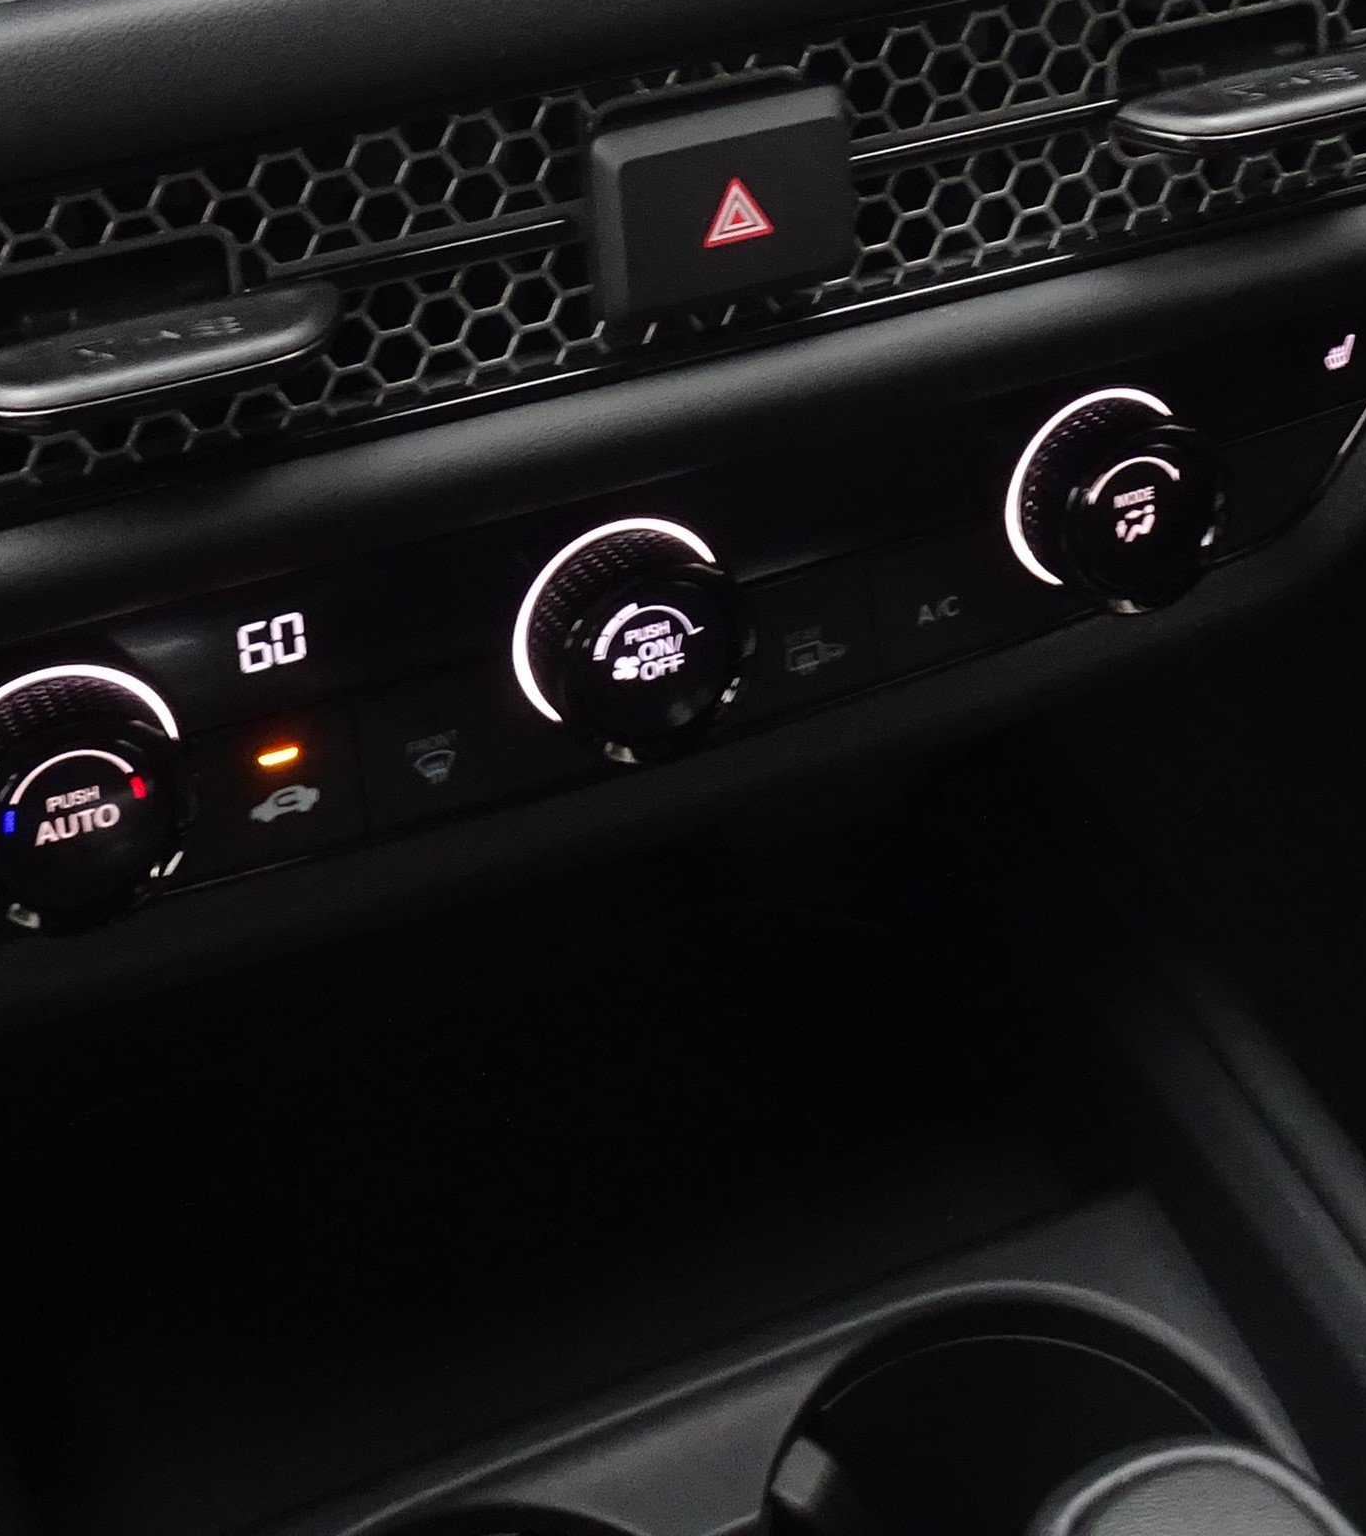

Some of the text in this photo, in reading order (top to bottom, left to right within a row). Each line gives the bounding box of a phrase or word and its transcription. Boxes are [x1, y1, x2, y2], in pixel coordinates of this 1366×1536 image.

[917, 594, 961, 626] A/C
[236, 611, 308, 674] 60
[623, 619, 671, 646] PUSH
[639, 651, 686, 681] OFF
[45, 784, 101, 814] PUSH
[34, 802, 121, 846] AUTO
